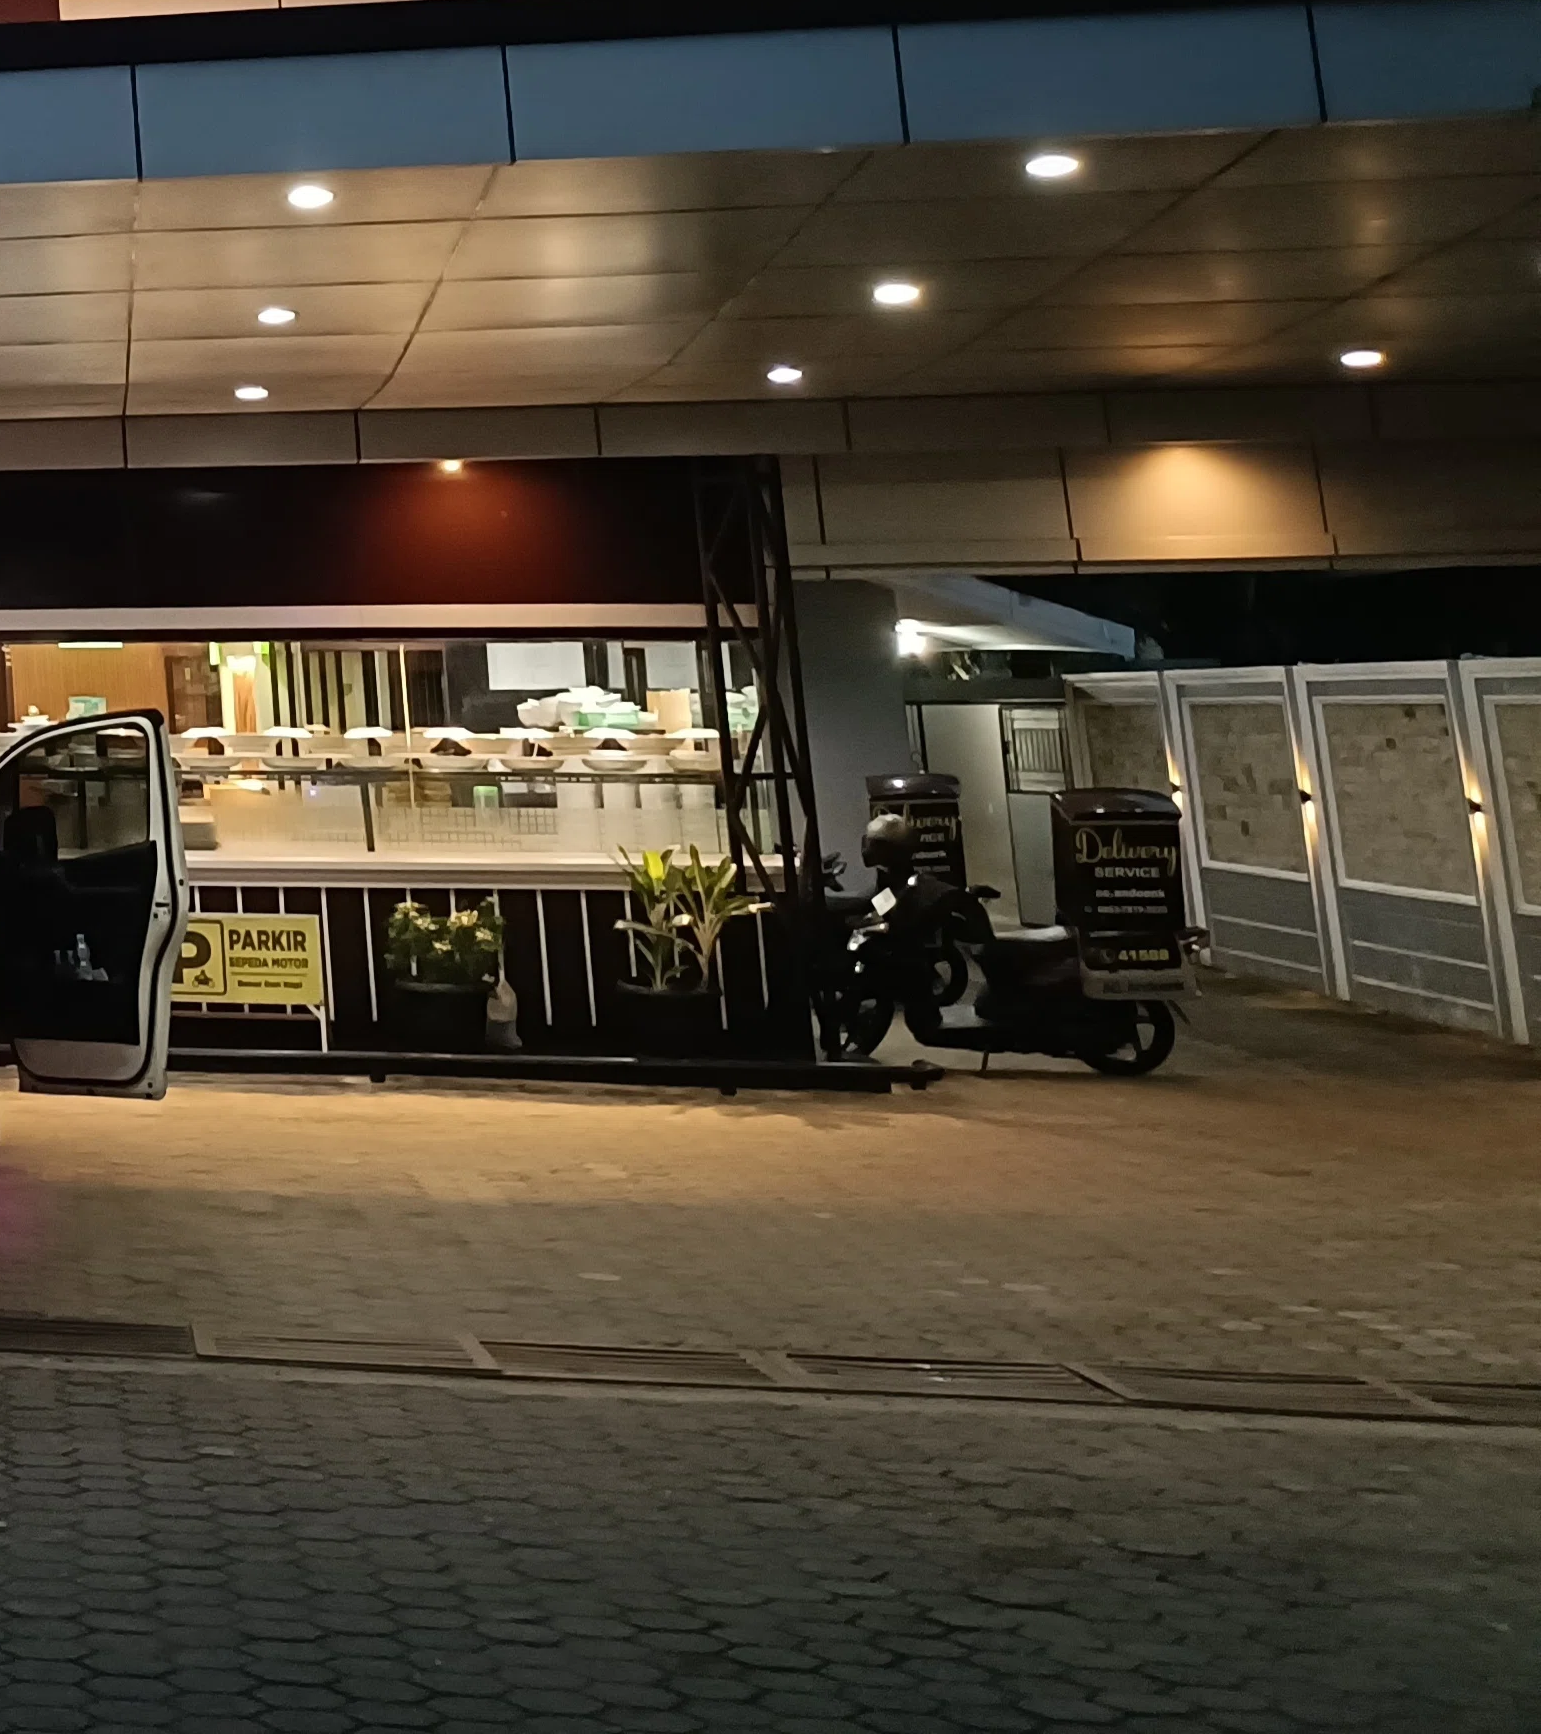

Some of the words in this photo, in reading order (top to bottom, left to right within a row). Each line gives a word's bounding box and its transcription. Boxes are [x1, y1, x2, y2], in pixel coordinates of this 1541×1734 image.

[1075, 827, 1177, 876] Delivery
[1095, 867, 1160, 878] SERVICE
[228, 929, 306, 952] PARKIR
[172, 931, 211, 984] P
[229, 957, 269, 968] SEPEDA
[272, 957, 308, 969] MOTOR
